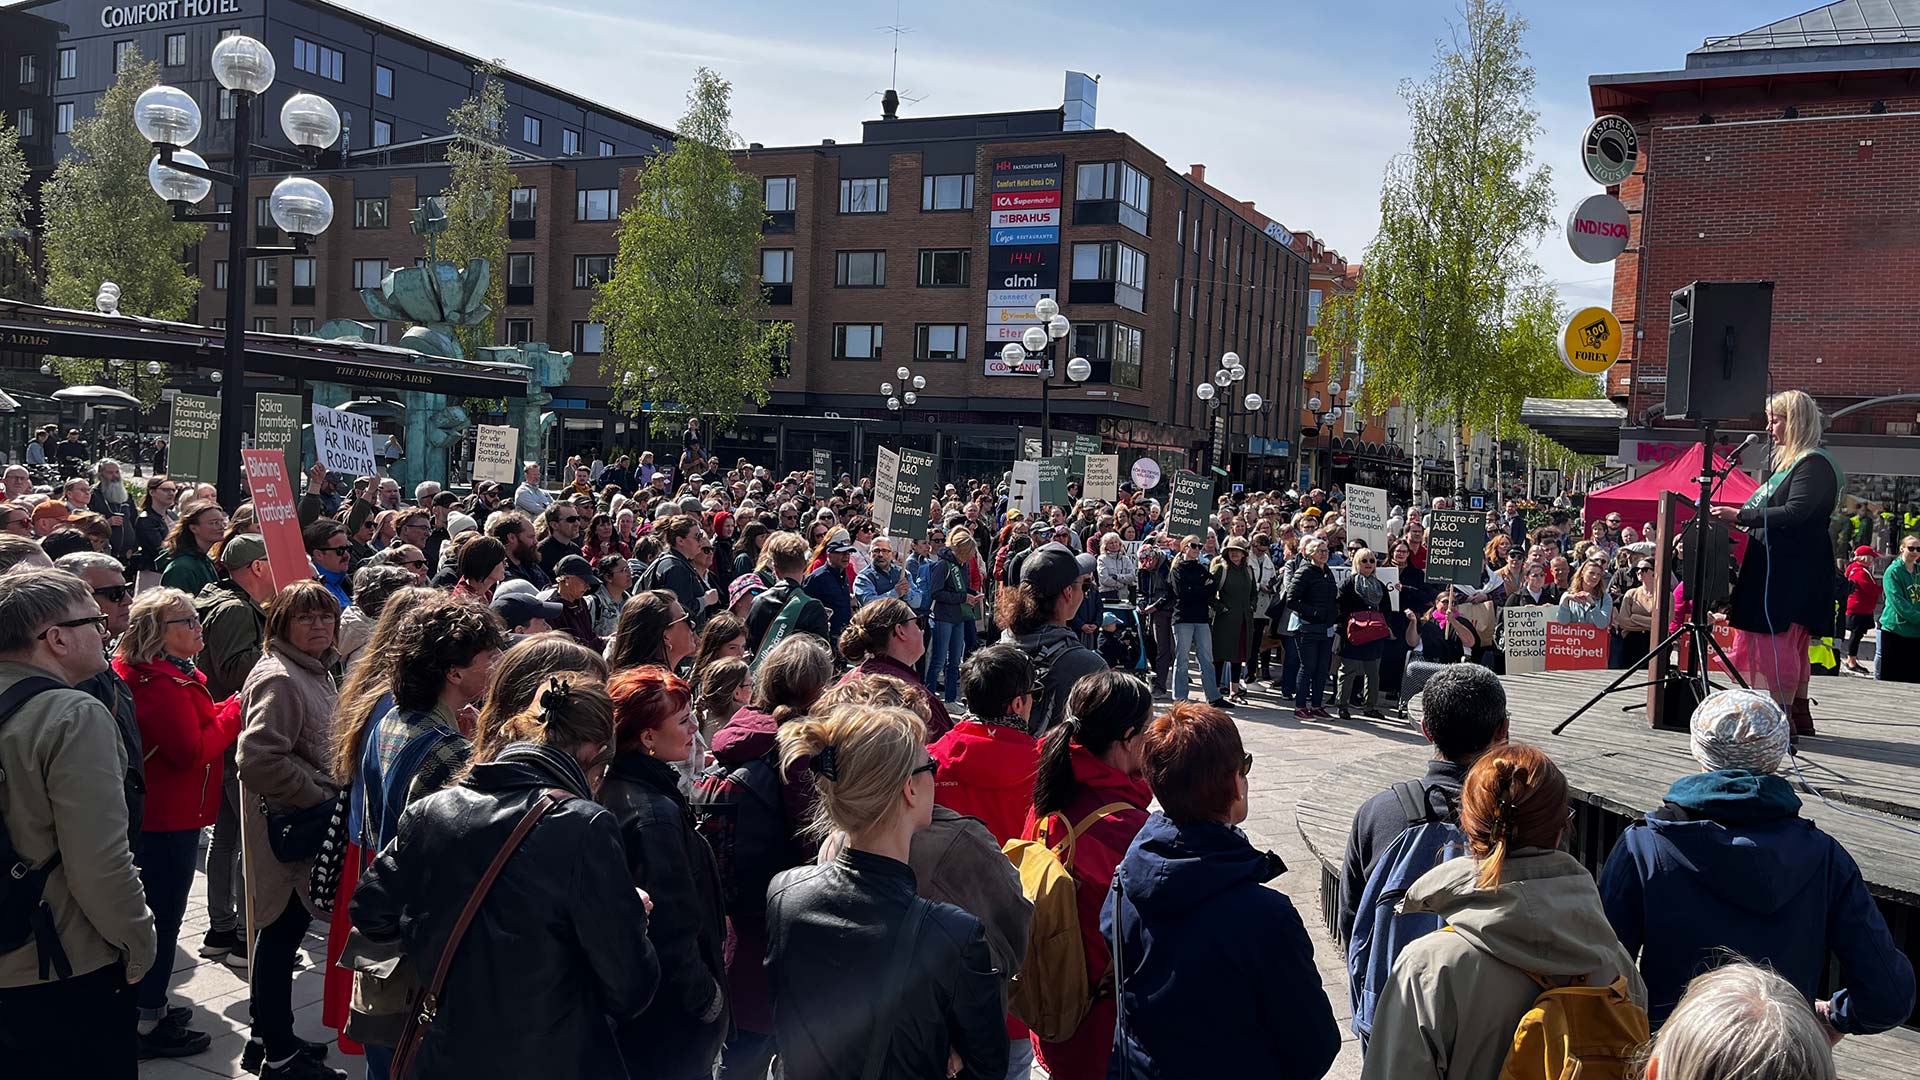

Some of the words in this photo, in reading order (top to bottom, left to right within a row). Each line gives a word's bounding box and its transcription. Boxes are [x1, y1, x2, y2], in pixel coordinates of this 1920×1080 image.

[102, 1, 178, 28] COMFORT
[184, 0, 239, 17] HOTEL
[1592, 119, 1635, 146] ESPRESSO
[1594, 164, 1627, 180] HOUSE
[1045, 178, 1055, 186] City
[997, 198, 1012, 206] ICA
[1013, 197, 1055, 206] Supermarket
[1575, 218, 1628, 239] INDISKA
[1004, 273, 1038, 287] almi
[1000, 328, 1023, 338] Eter
[1586, 324, 1604, 336] 100
[7, 334, 49, 345] ARMS
[1576, 351, 1608, 362] FOREX
[336, 367, 356, 376] THE
[404, 374, 432, 384] ARMS
[176, 396, 206, 409] Säkra
[260, 398, 282, 413] Säkra
[174, 418, 202, 429] satsa
[204, 419, 217, 431] på
[260, 413, 298, 430] framtiden,
[328, 411, 370, 438] LÄRARE
[174, 428, 209, 439] skolan!
[259, 430, 280, 442] satsa
[281, 428, 292, 445] på
[480, 427, 506, 436] Barnen
[324, 428, 341, 450] ÄR
[344, 435, 368, 456] INGA
[500, 449, 509, 457] på
[902, 452, 924, 465] Lärare
[925, 457, 933, 466] är
[327, 449, 375, 476] ROBOTAR
[247, 456, 282, 482] Bildning
[900, 464, 918, 475] A&O.
[898, 482, 920, 494] Rädda
[1177, 477, 1200, 488] Lärare
[1202, 482, 1210, 490] är
[266, 483, 278, 498] en
[1176, 485, 1195, 496] A&O.
[1349, 487, 1374, 497] Barnen
[896, 494, 912, 504] real-
[1174, 498, 1198, 510] Rädda
[260, 499, 296, 525] rättighet!
[894, 504, 922, 516] lönerna!
[1349, 502, 1377, 513] framtid.
[1171, 514, 1202, 526] lönerna!
[1350, 510, 1370, 520] Satsa
[1434, 512, 1466, 523] Lärare
[1468, 514, 1480, 524] är
[1349, 519, 1383, 530] förskolan!
[1433, 522, 1459, 532] A&O.
[1432, 537, 1464, 547] Rädda
[1431, 547, 1453, 555] real-
[1430, 555, 1471, 566] lönerna!
[1508, 610, 1543, 618] Barnen
[1520, 618, 1536, 627] vår
[1550, 625, 1595, 639] Bildning
[1540, 640, 1546, 648] p
[1510, 648, 1546, 657] förskol
[1550, 645, 1603, 658] rättighet!
